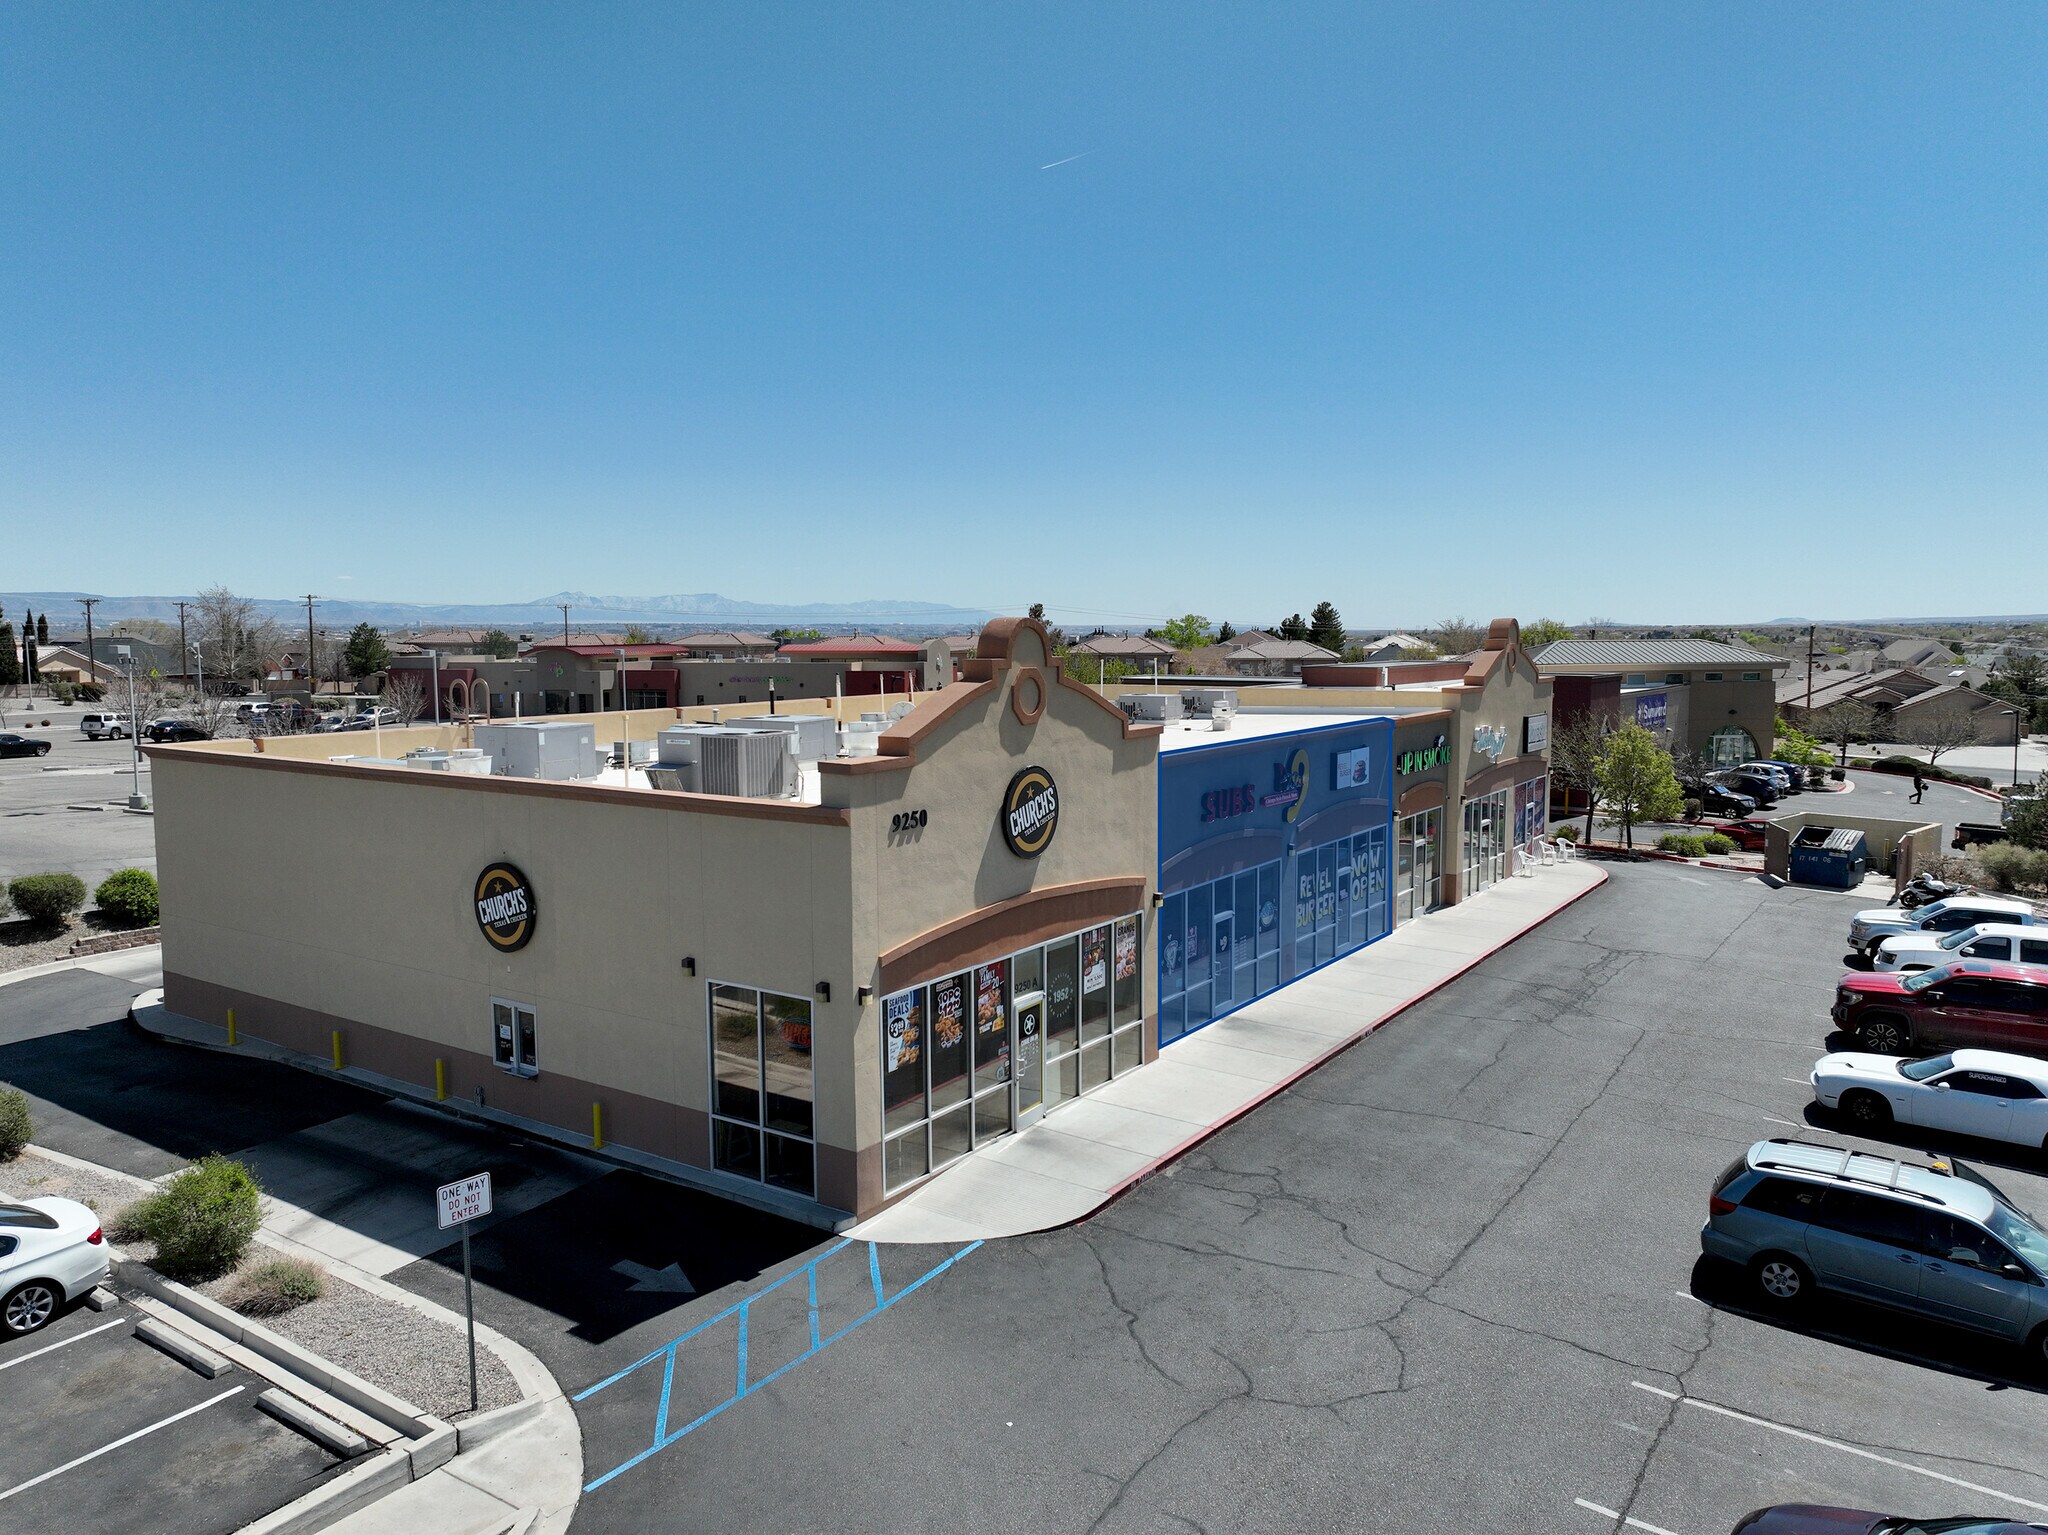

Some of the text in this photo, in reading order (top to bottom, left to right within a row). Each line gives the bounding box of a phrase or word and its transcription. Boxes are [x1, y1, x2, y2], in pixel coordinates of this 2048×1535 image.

[1401, 745, 1451, 775] UP IN SMOKE
[1010, 787, 1055, 836] CHURCH'S
[1203, 784, 1255, 823] SUBS
[892, 809, 928, 833] 9250
[1024, 811, 1055, 837] TEXAS CHICKEN
[1351, 846, 1380, 878] NOW
[1351, 868, 1385, 901] OPEN
[478, 888, 527, 924] CHURCH'S
[493, 913, 528, 928] TEXAS CHICKEN
[1015, 977, 1039, 994] 9250 A
[1053, 987, 1069, 1004] 1952
[889, 994, 909, 1008] SEAFOOD
[889, 1002, 909, 1019] DEALS
[442, 1177, 486, 1201] ONE WAY
[449, 1191, 481, 1211] DO NOT
[452, 1204, 480, 1221] ENTER
